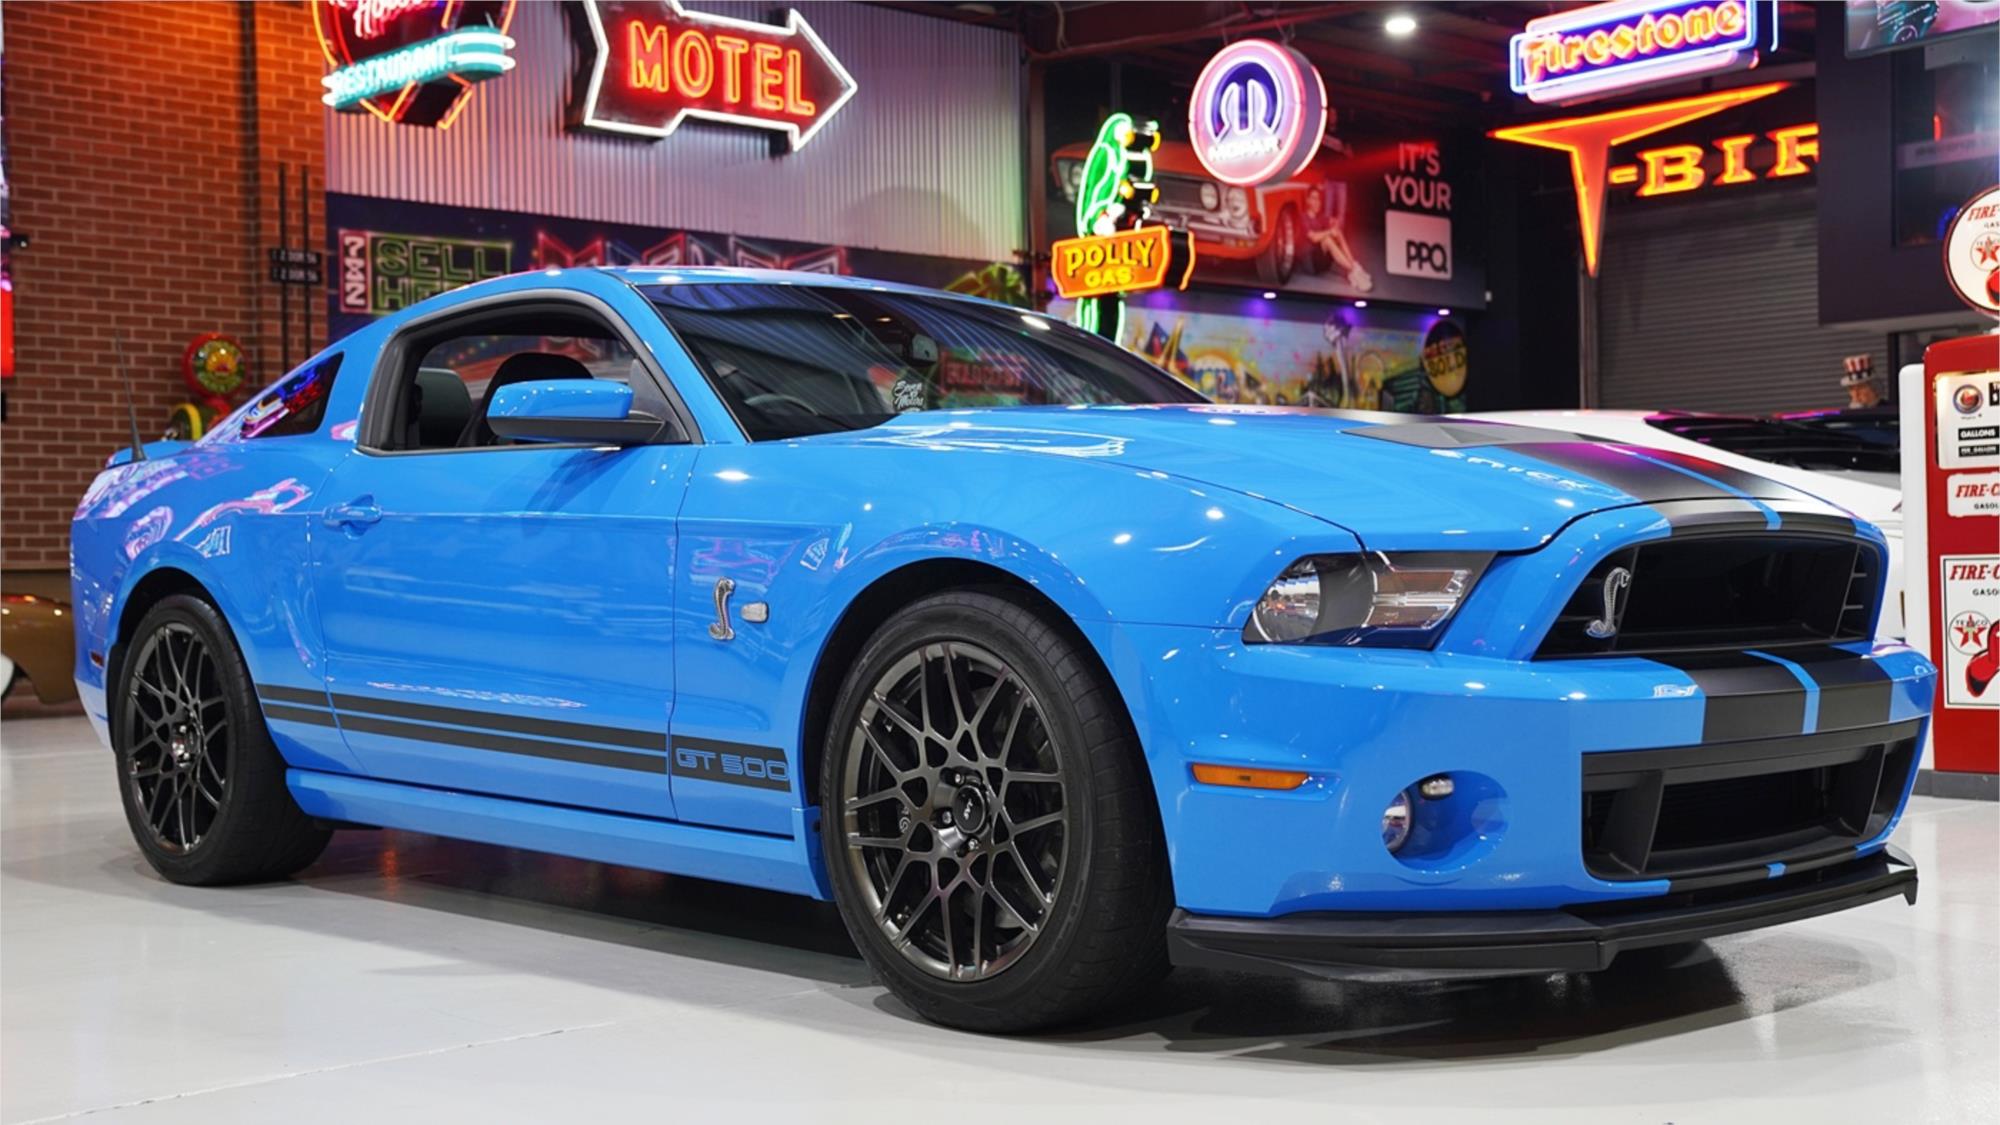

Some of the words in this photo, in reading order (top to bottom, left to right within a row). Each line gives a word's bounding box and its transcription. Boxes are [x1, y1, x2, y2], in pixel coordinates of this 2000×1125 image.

[1522, 1, 1746, 83] Firestone
[333, 39, 449, 100] RESTAURANT
[629, 20, 815, 116] MOTEL
[1400, 142, 1440, 176] IT'S
[1385, 174, 1451, 211] YOUR
[376, 239, 508, 281] SELL
[1064, 238, 1155, 277] POLLY
[1406, 240, 1448, 273] PPQ
[1085, 267, 1132, 287] GAS
[1960, 428, 1995, 438] GALLONS
[675, 748, 717, 770] GT
[721, 753, 789, 781] 500
